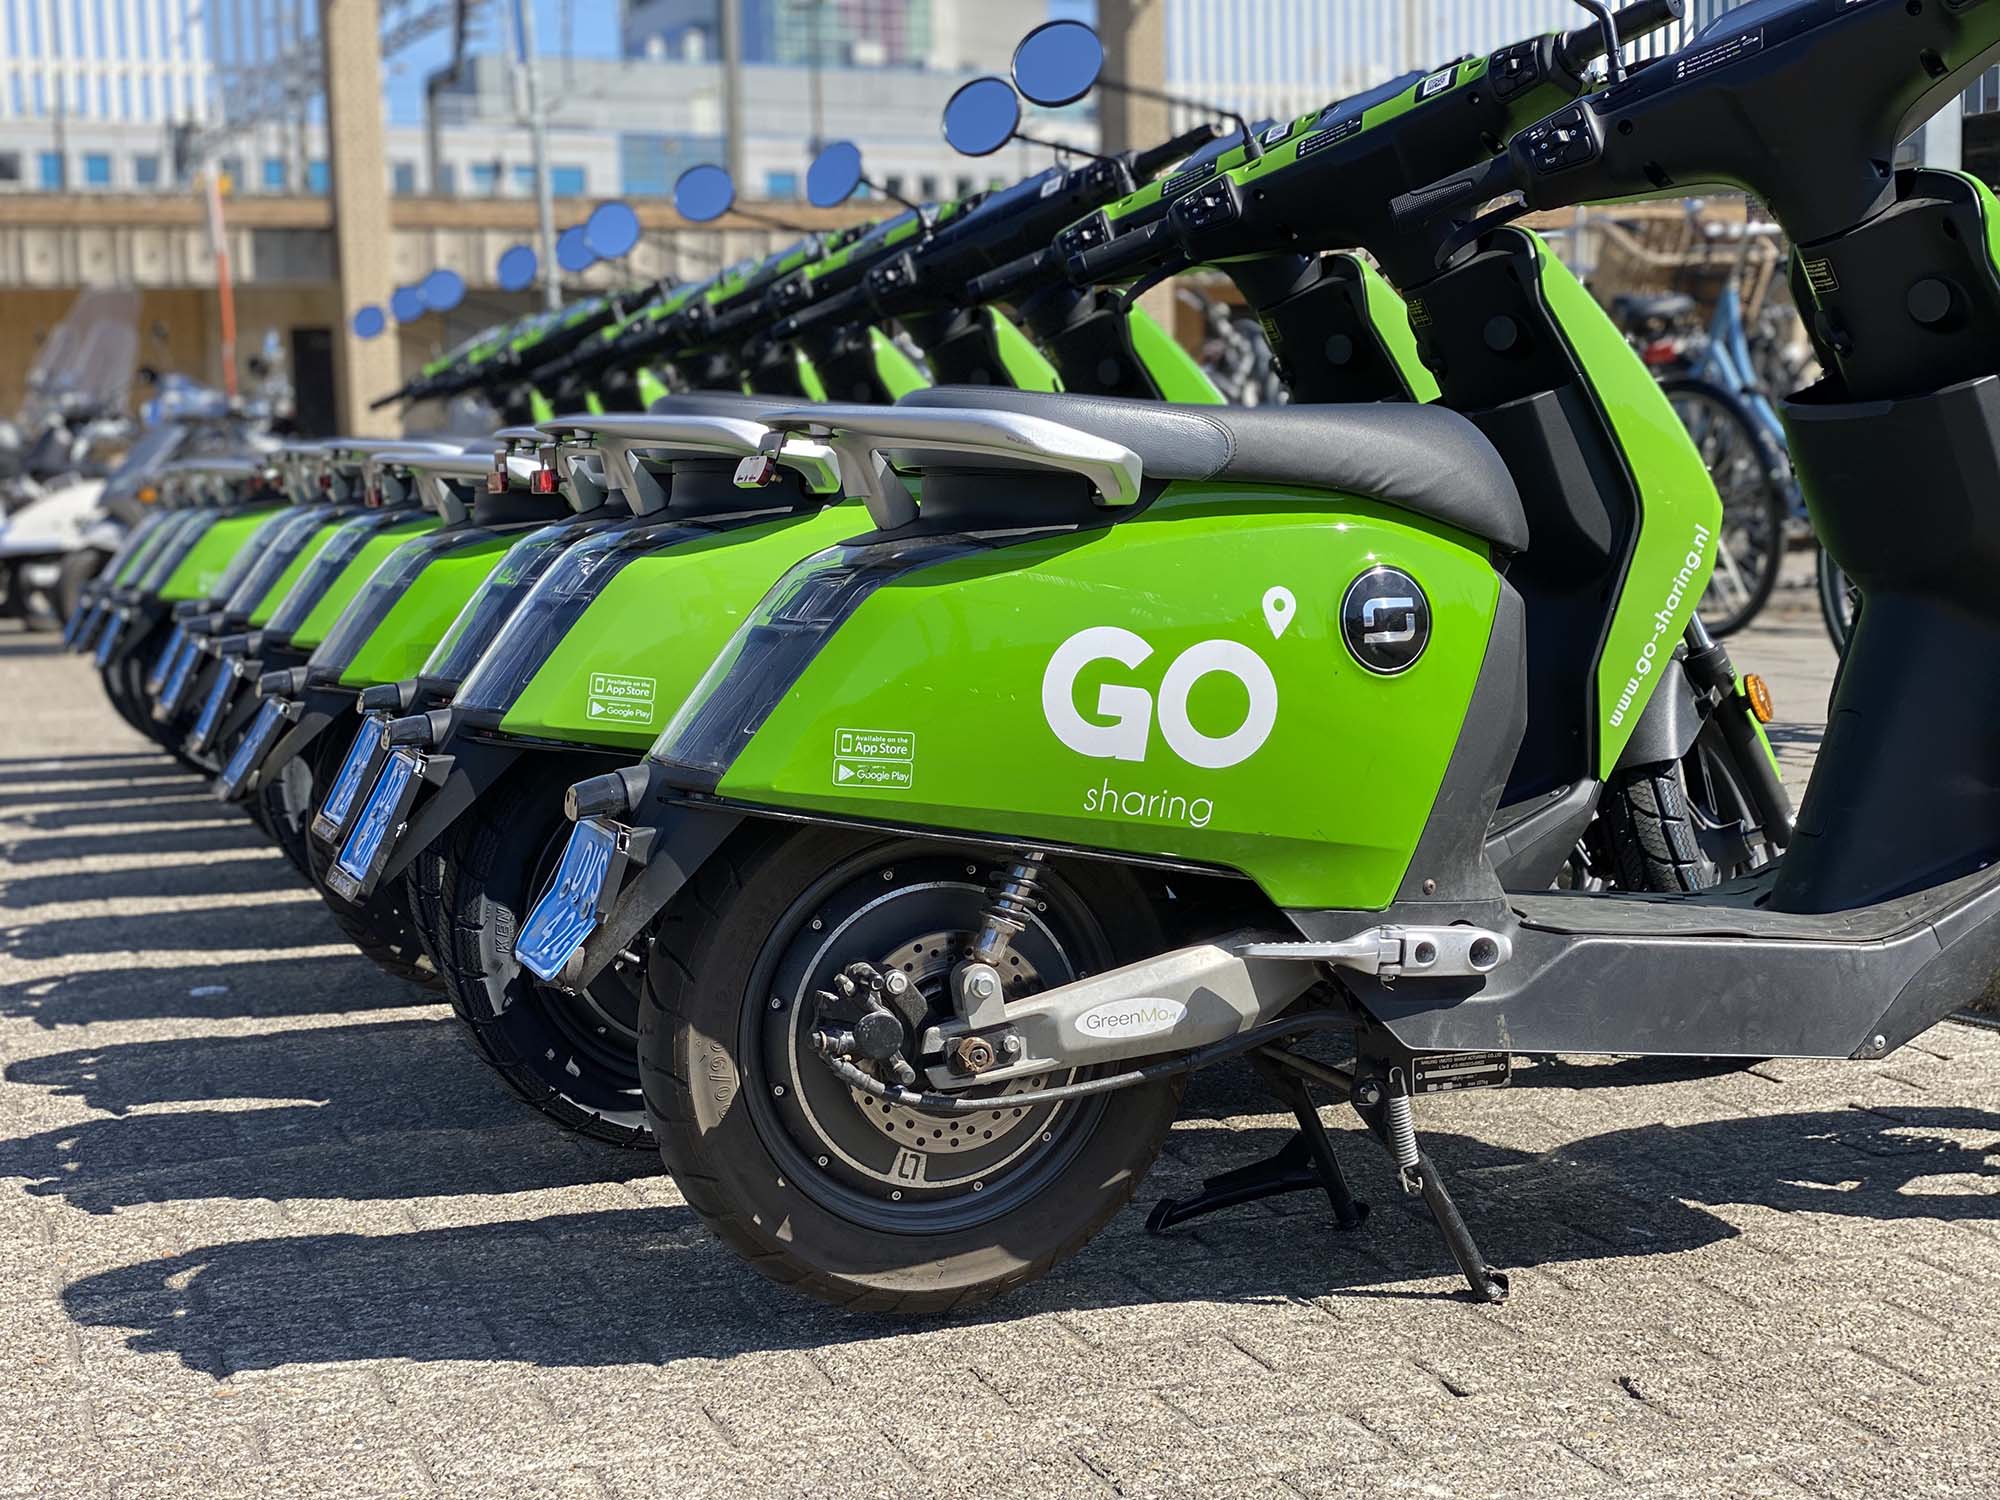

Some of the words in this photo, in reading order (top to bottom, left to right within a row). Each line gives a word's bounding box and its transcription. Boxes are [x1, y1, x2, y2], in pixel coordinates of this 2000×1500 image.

[1609, 523, 1710, 727] www.go-sharing.nl
[606, 684, 625, 695] App
[626, 686, 650, 696] Store
[1042, 626, 1278, 769] GO
[606, 706, 634, 717] Google
[635, 709, 650, 719] Play
[855, 735, 886, 743] Available
[855, 742, 878, 756] App
[879, 743, 908, 755] Store
[856, 769, 890, 782] Google
[891, 771, 910, 783] Play
[1083, 777, 1214, 827] sharing
